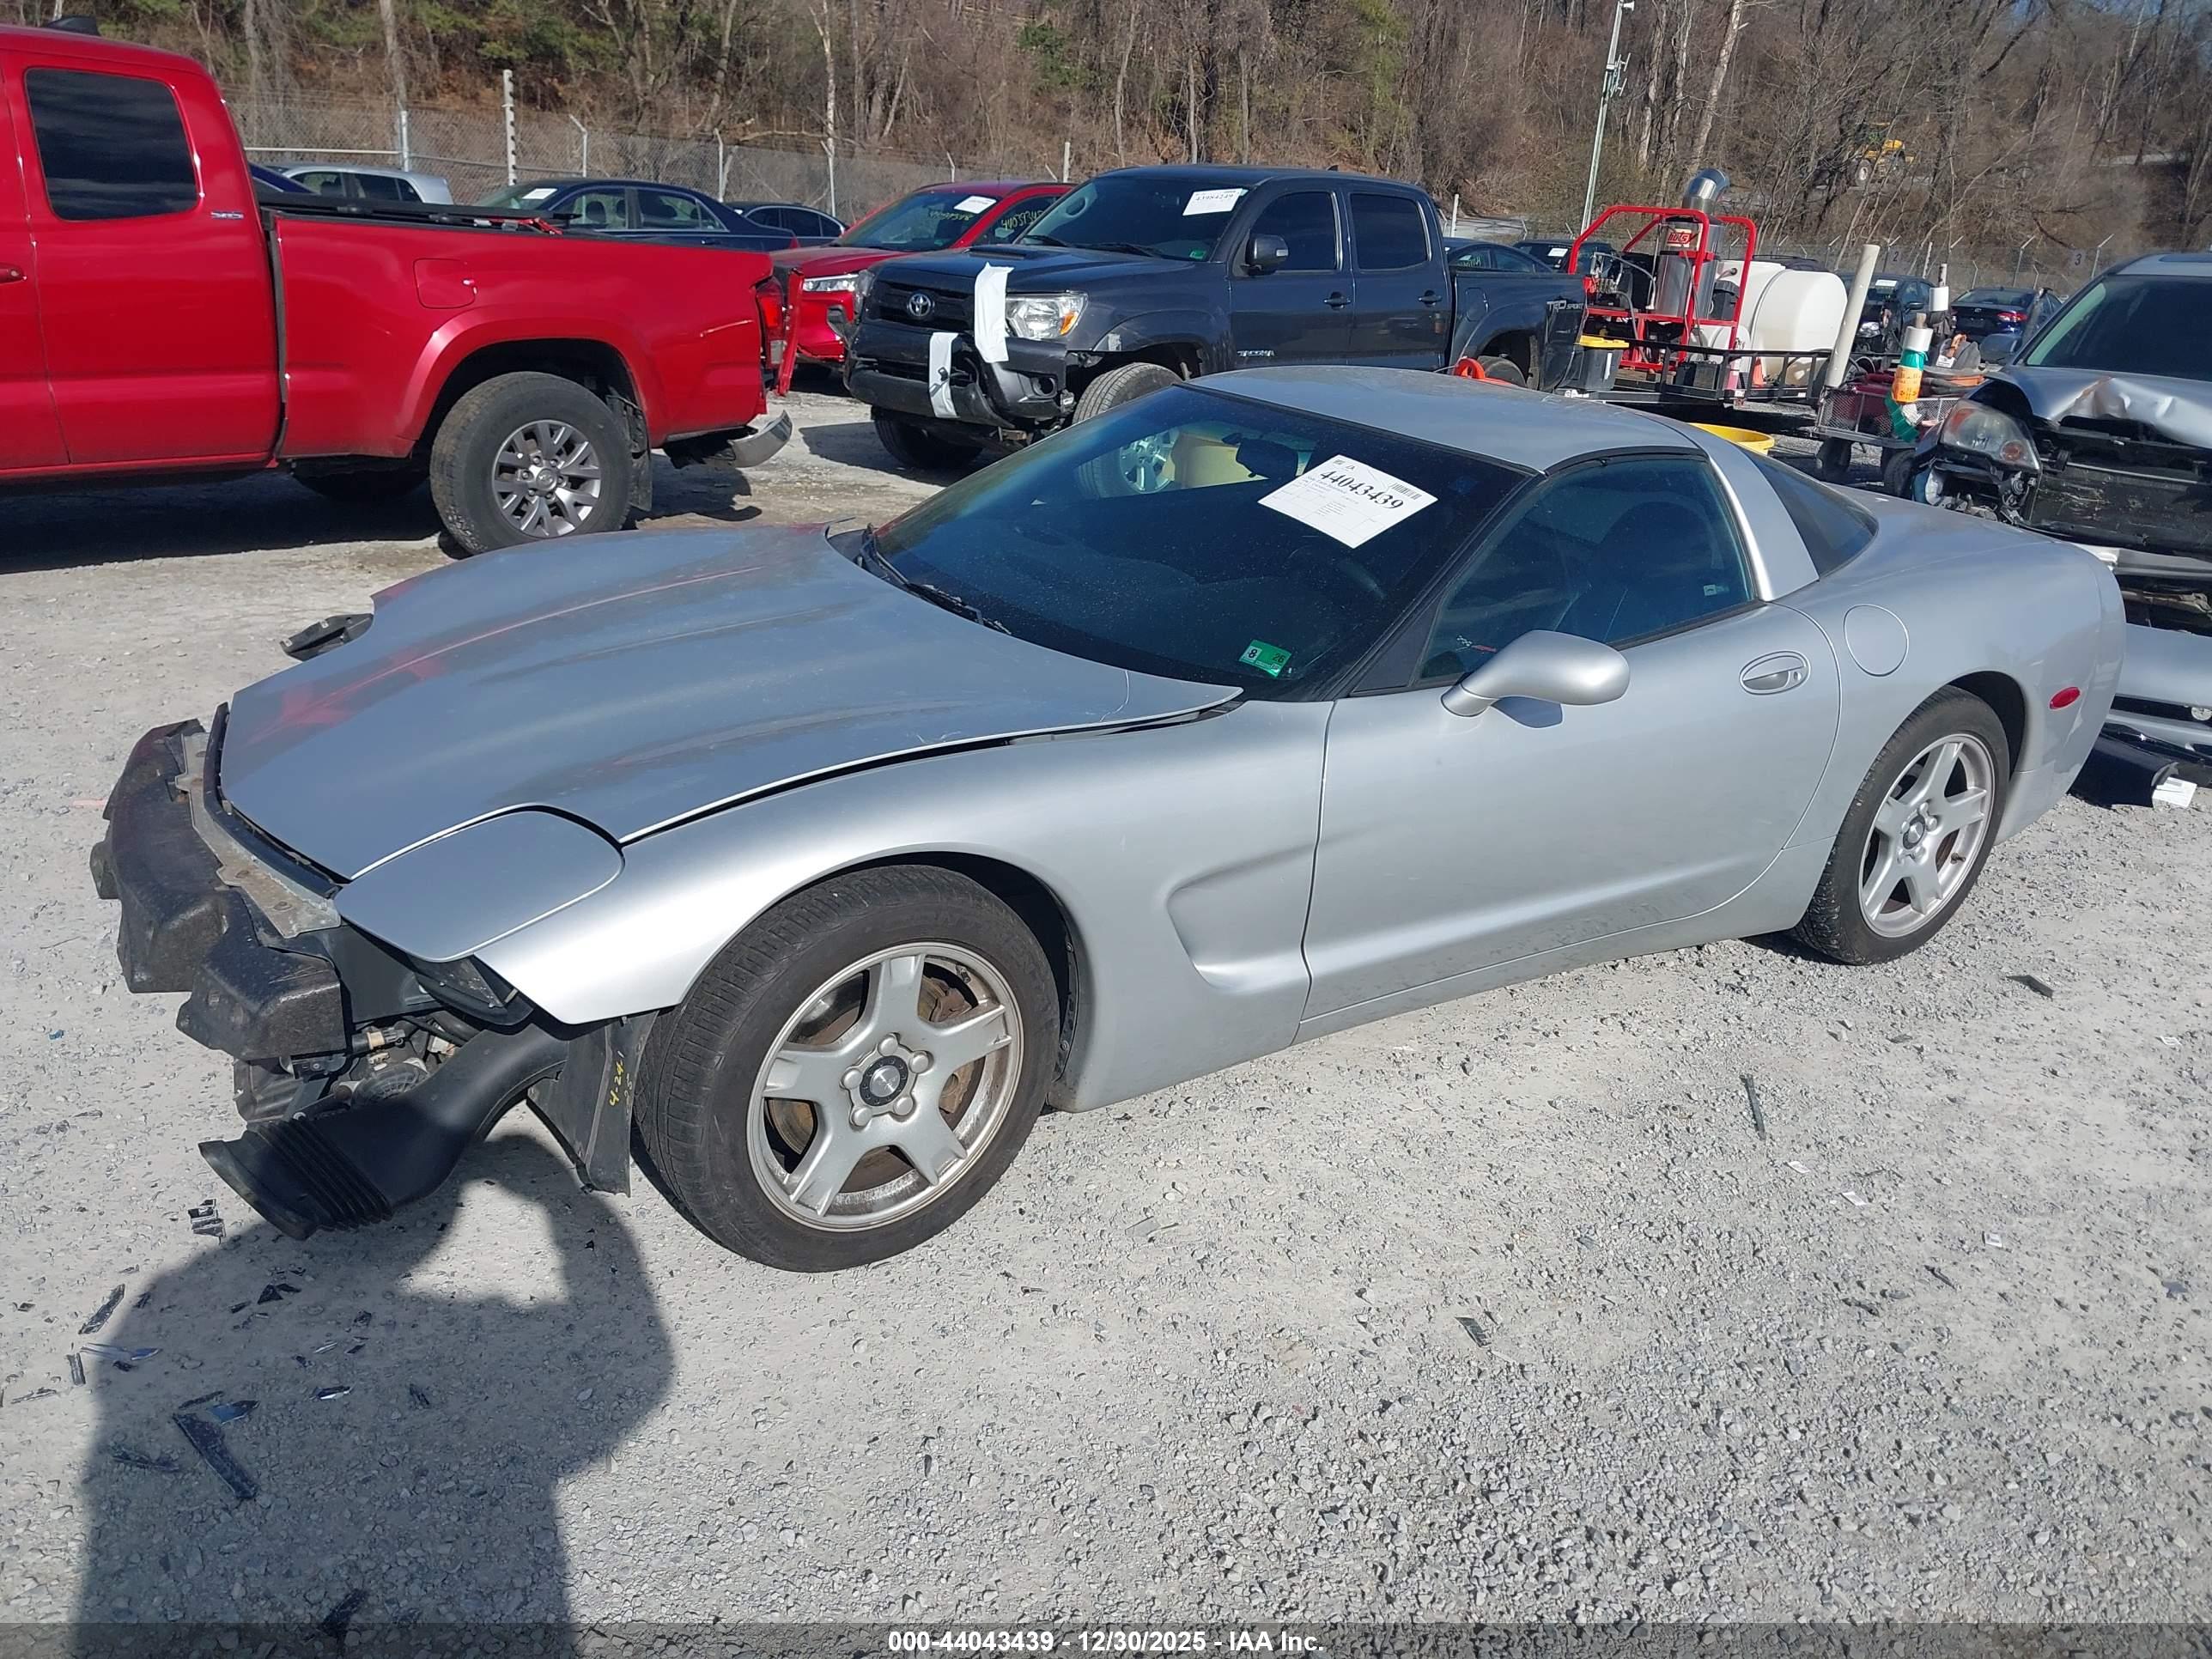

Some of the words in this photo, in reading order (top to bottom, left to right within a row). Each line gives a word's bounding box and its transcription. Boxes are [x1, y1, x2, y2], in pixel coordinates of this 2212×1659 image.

[1893, 251, 1899, 262] 2
[2075, 253, 2082, 266] 3
[1320, 470, 1404, 509] 44043439
[1248, 648, 1258, 659] 8
